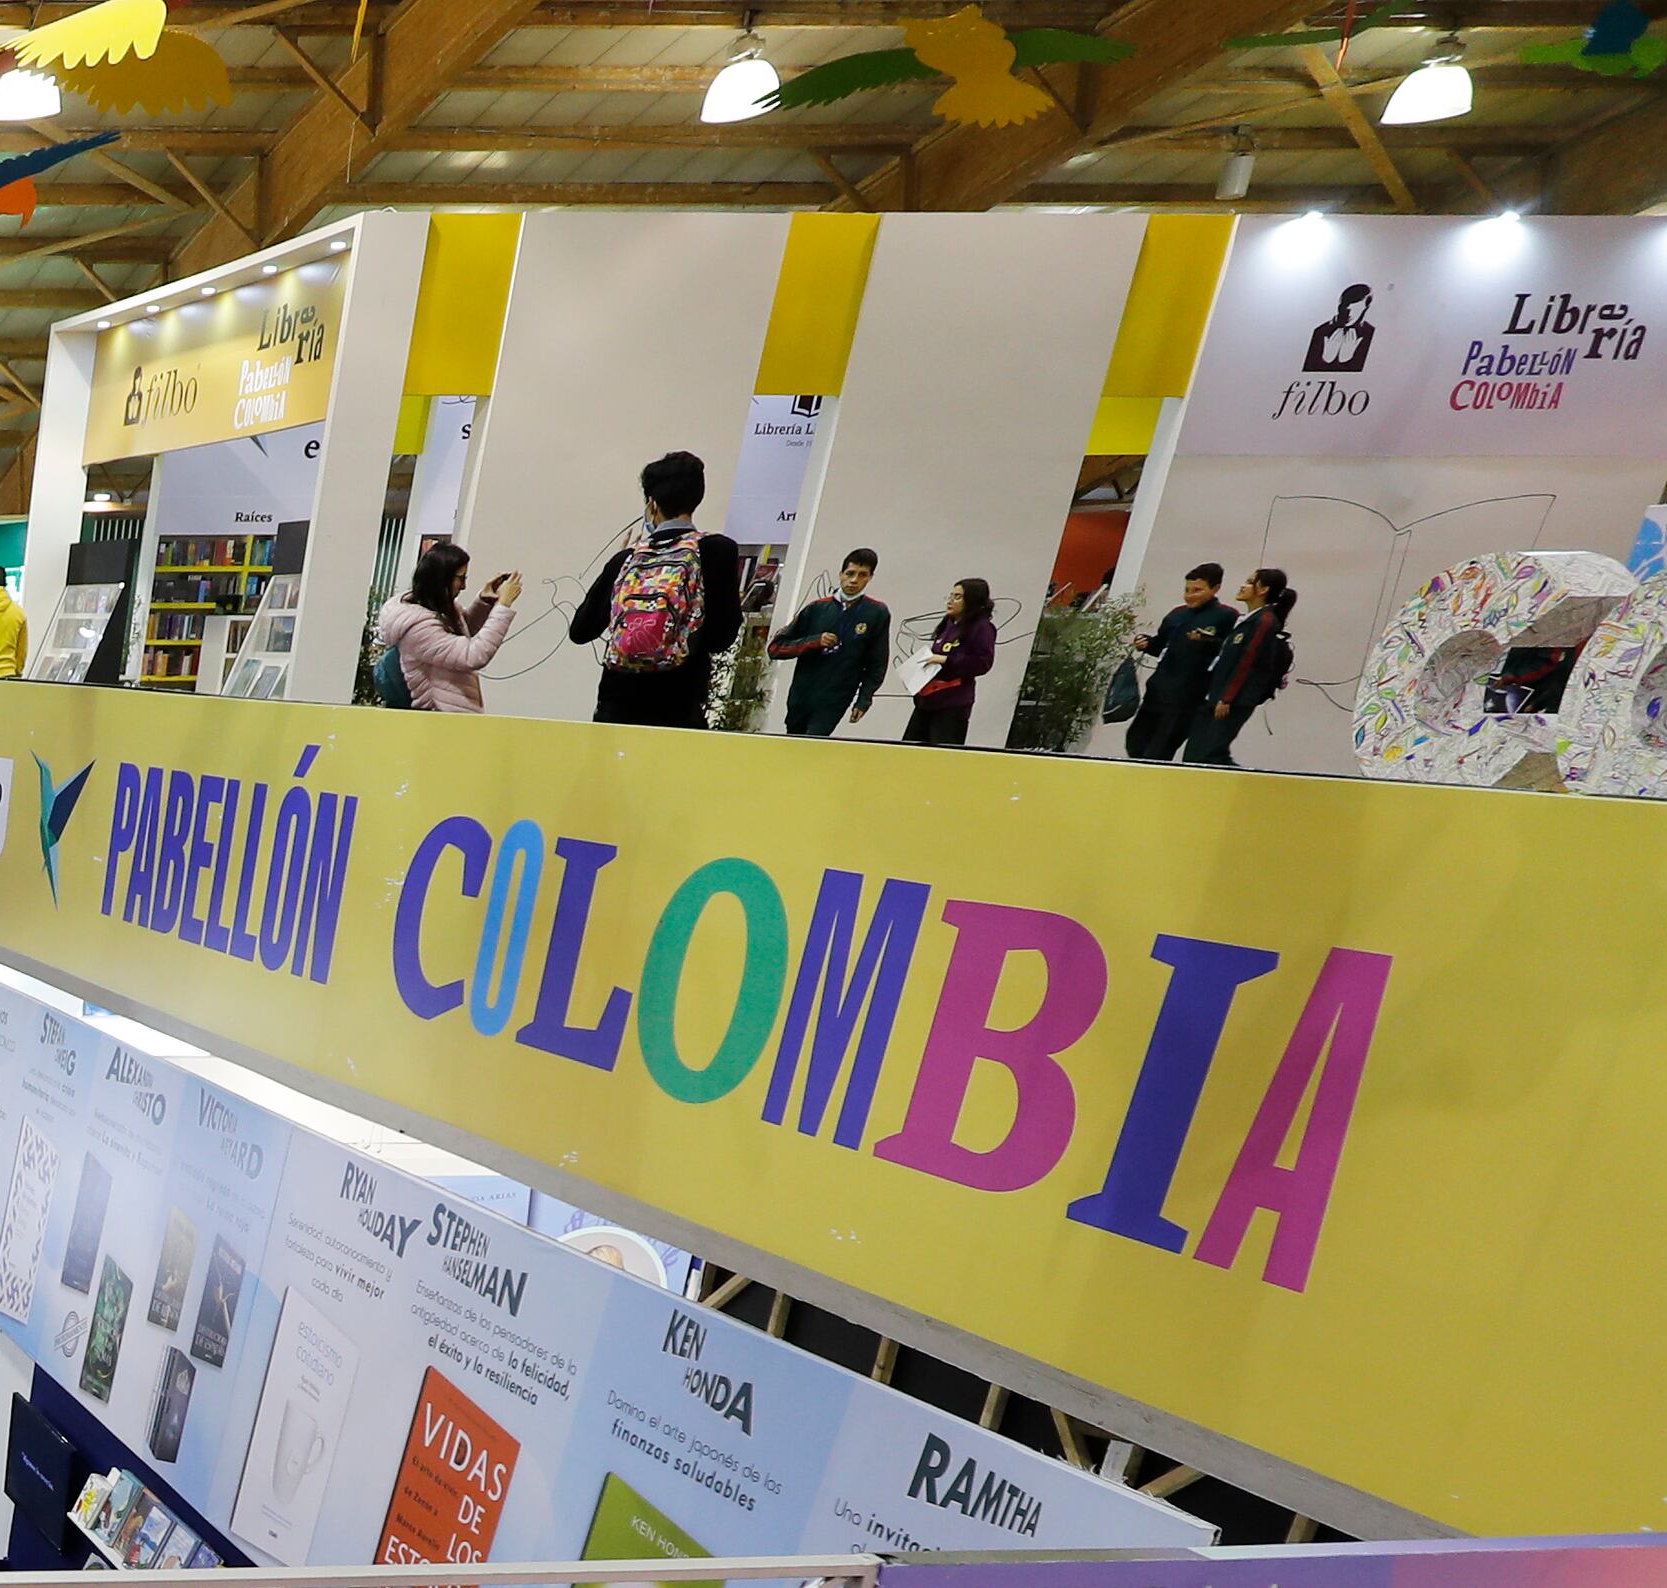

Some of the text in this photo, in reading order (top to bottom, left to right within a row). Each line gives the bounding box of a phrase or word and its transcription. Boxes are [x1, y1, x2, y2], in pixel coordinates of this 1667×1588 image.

[142, 368, 198, 428] filbo
[1272, 379, 1370, 421] filbo
[754, 422, 802, 435] Librería
[235, 511, 273, 523] Raíces
[100, 744, 359, 985] PABELLÓN
[390, 815, 1396, 1296] COLOMBIA
[340, 1160, 378, 1206] RYAN
[358, 1206, 424, 1260] HOLIDAY
[426, 1202, 491, 1259] STEPHEN
[442, 1255, 529, 1318] HANSELMAN
[661, 1308, 709, 1362] KEN
[683, 1366, 755, 1438] HONDA
[423, 1401, 509, 1503] VIDAS
[610, 1418, 758, 1513] finanzas saludables
[458, 1494, 486, 1536] DE
[906, 1432, 1043, 1540] RAMTHA
